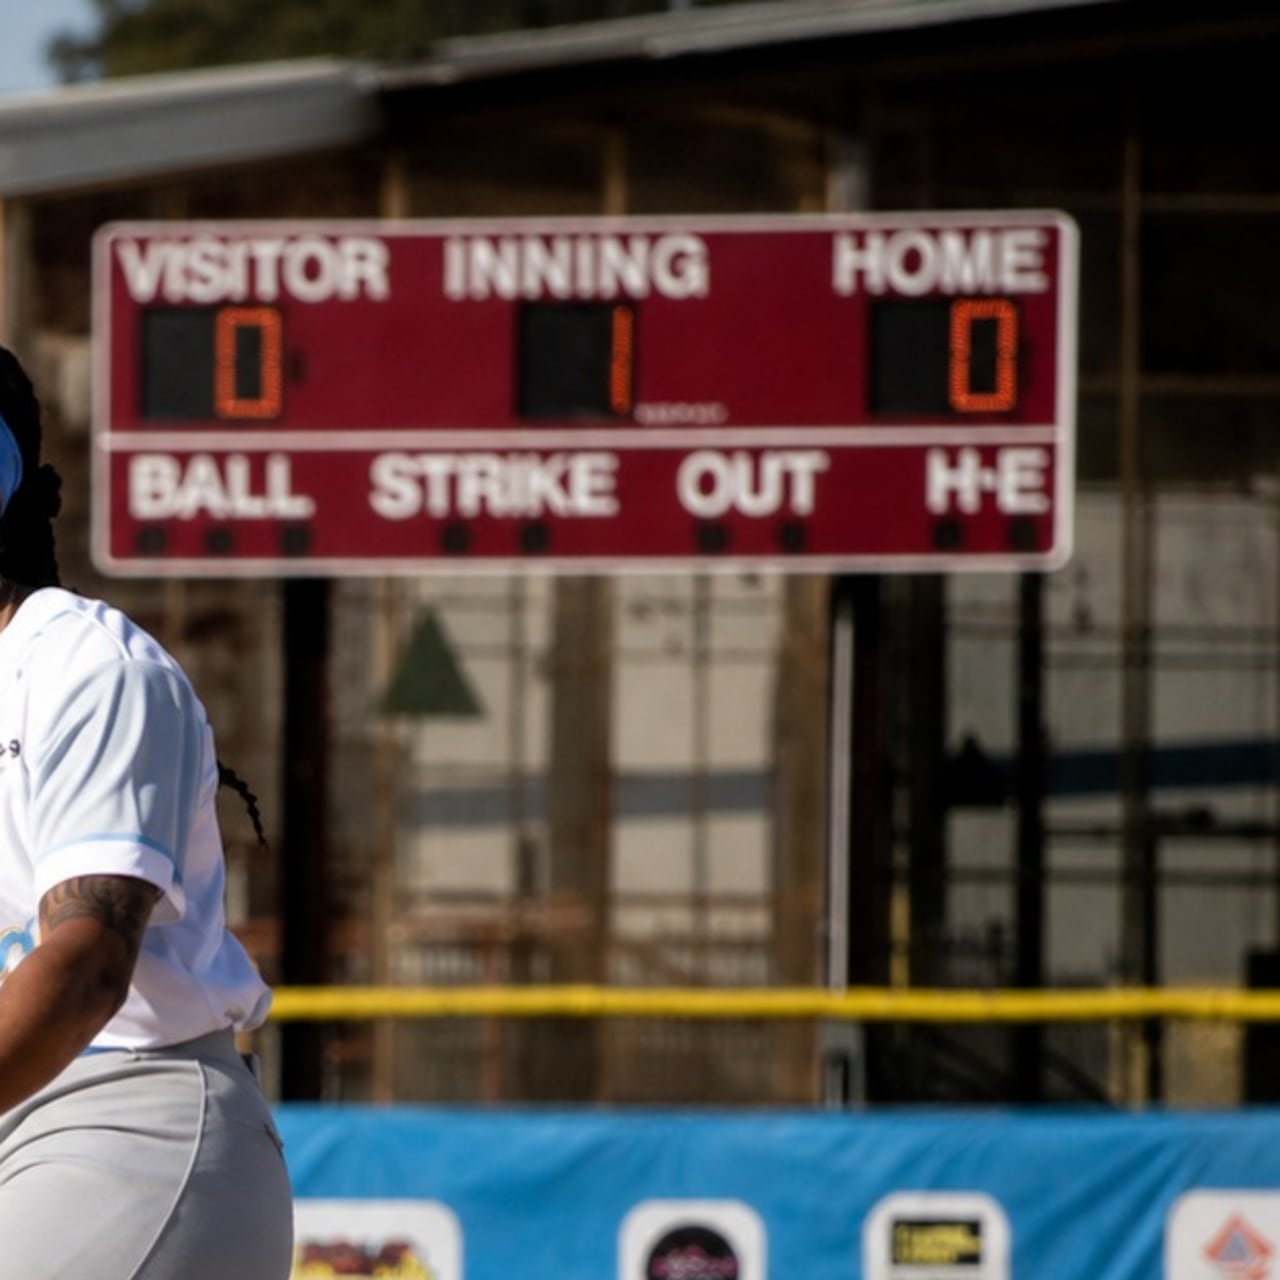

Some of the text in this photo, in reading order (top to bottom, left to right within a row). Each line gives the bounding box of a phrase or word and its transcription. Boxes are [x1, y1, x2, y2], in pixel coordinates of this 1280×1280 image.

[118, 228, 1048, 302] VISITOR INNING HOME
[214, 306, 282, 417] 0
[949, 300, 1017, 412] 0
[128, 452, 316, 520] BALL
[368, 450, 620, 520] STRIKE
[677, 449, 830, 518] OUT
